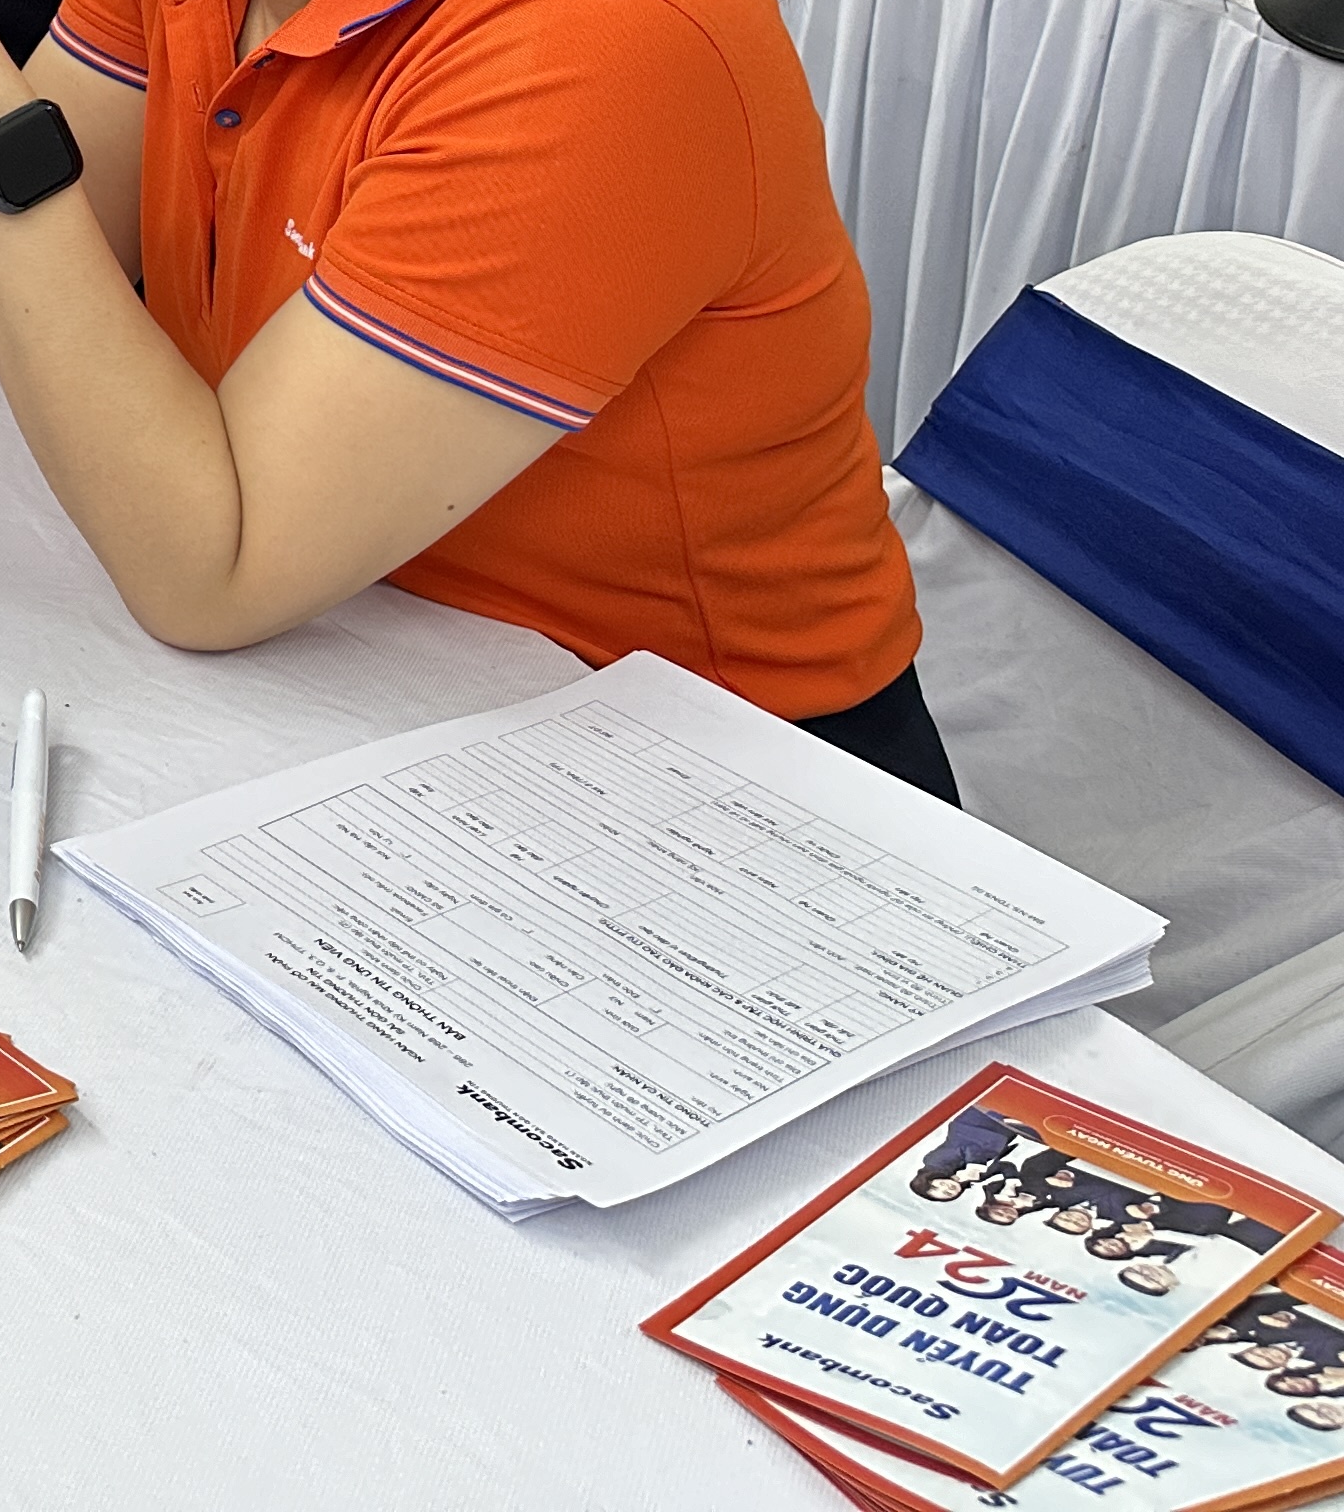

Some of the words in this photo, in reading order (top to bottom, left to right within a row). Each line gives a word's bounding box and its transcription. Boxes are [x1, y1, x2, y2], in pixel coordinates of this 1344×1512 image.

[314, 938, 342, 958] VIÊN
[265, 952, 291, 970] PHẦN
[306, 967, 322, 979] TÍN
[342, 957, 371, 976] ỨNG
[306, 979, 325, 992] MẠI
[323, 978, 363, 1006] THƯƠNG
[370, 976, 391, 991] TIN
[324, 992, 365, 1021] THƯƠNG
[364, 1006, 387, 1022] GÒN
[392, 991, 436, 1022] THÔNG
[365, 1021, 395, 1041] HÀNG
[387, 1022, 405, 1034] SÀI
[436, 1021, 465, 1040] BẢN
[394, 1041, 424, 1062] NGÂN
[457, 1085, 590, 1169] Sacombank
[831, 1262, 950, 1320] QUỐC
[1022, 1269, 1089, 1302] NĂM
[780, 1279, 902, 1340] DỤNG
[949, 1309, 1068, 1370] TOÀN
[897, 1328, 1036, 1396] TUYỂN
[757, 1332, 961, 1421] Sacombank
[1042, 1452, 1127, 1496] TUY
